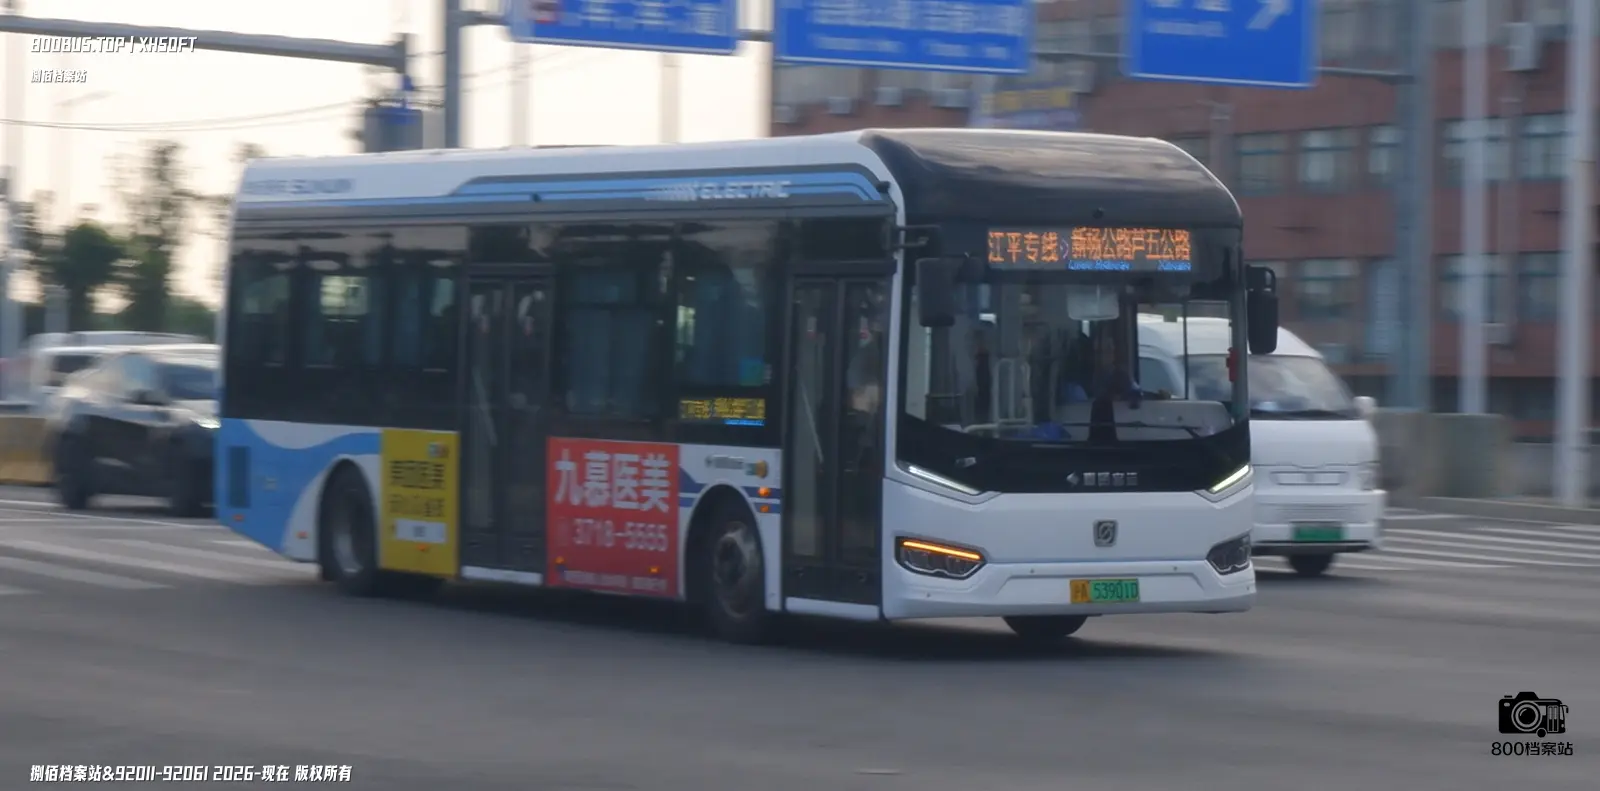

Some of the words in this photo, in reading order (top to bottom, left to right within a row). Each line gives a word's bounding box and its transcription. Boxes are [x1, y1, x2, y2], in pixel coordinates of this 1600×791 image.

[988, 231, 1059, 263] 江平专线
[554, 448, 670, 513] 九慕医美
